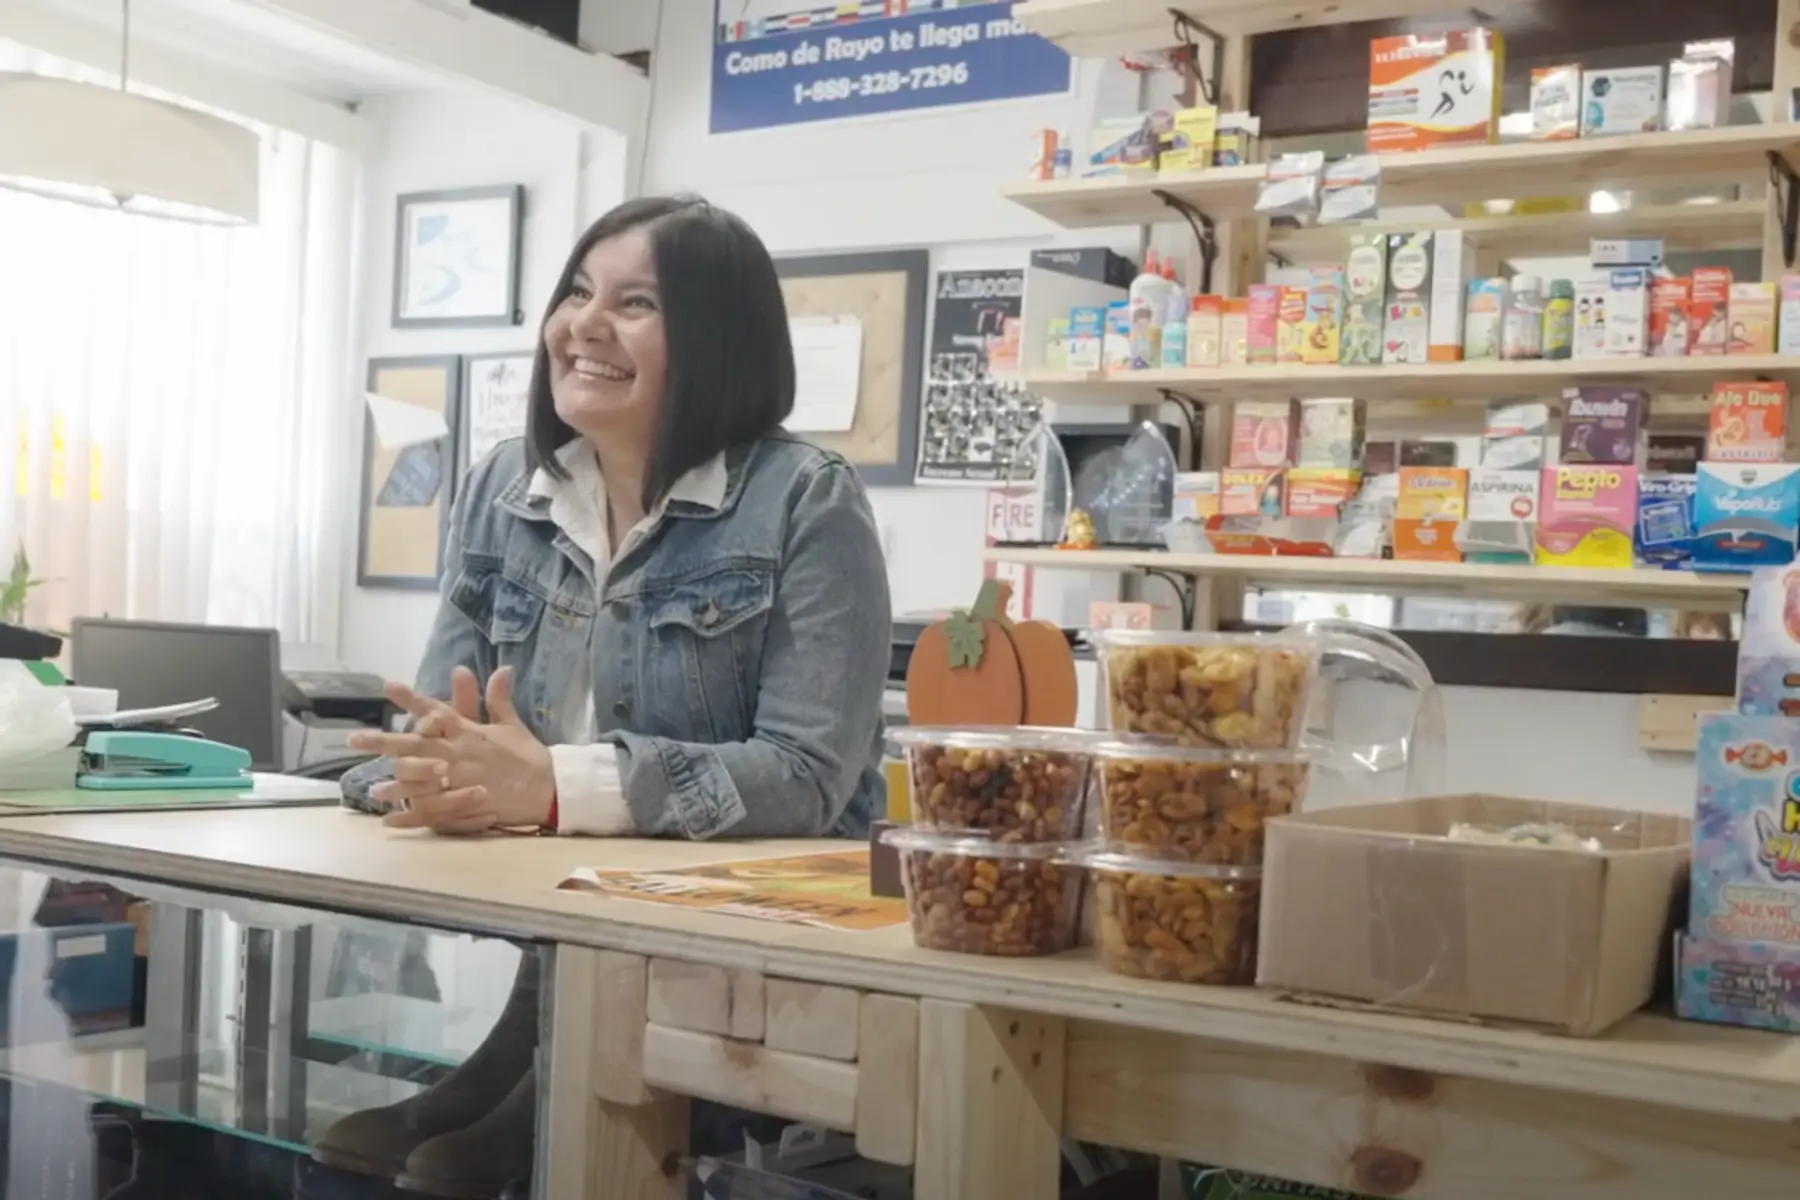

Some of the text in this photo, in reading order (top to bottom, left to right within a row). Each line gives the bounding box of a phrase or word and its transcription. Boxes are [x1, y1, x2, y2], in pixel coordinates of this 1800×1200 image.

[726, 18, 1036, 75] Como de Rayo te llega ma
[793, 62, 969, 104] 1-888-328-7296
[1471, 482, 1535, 494] ASPIRINA
[991, 503, 1035, 528] FIRE
